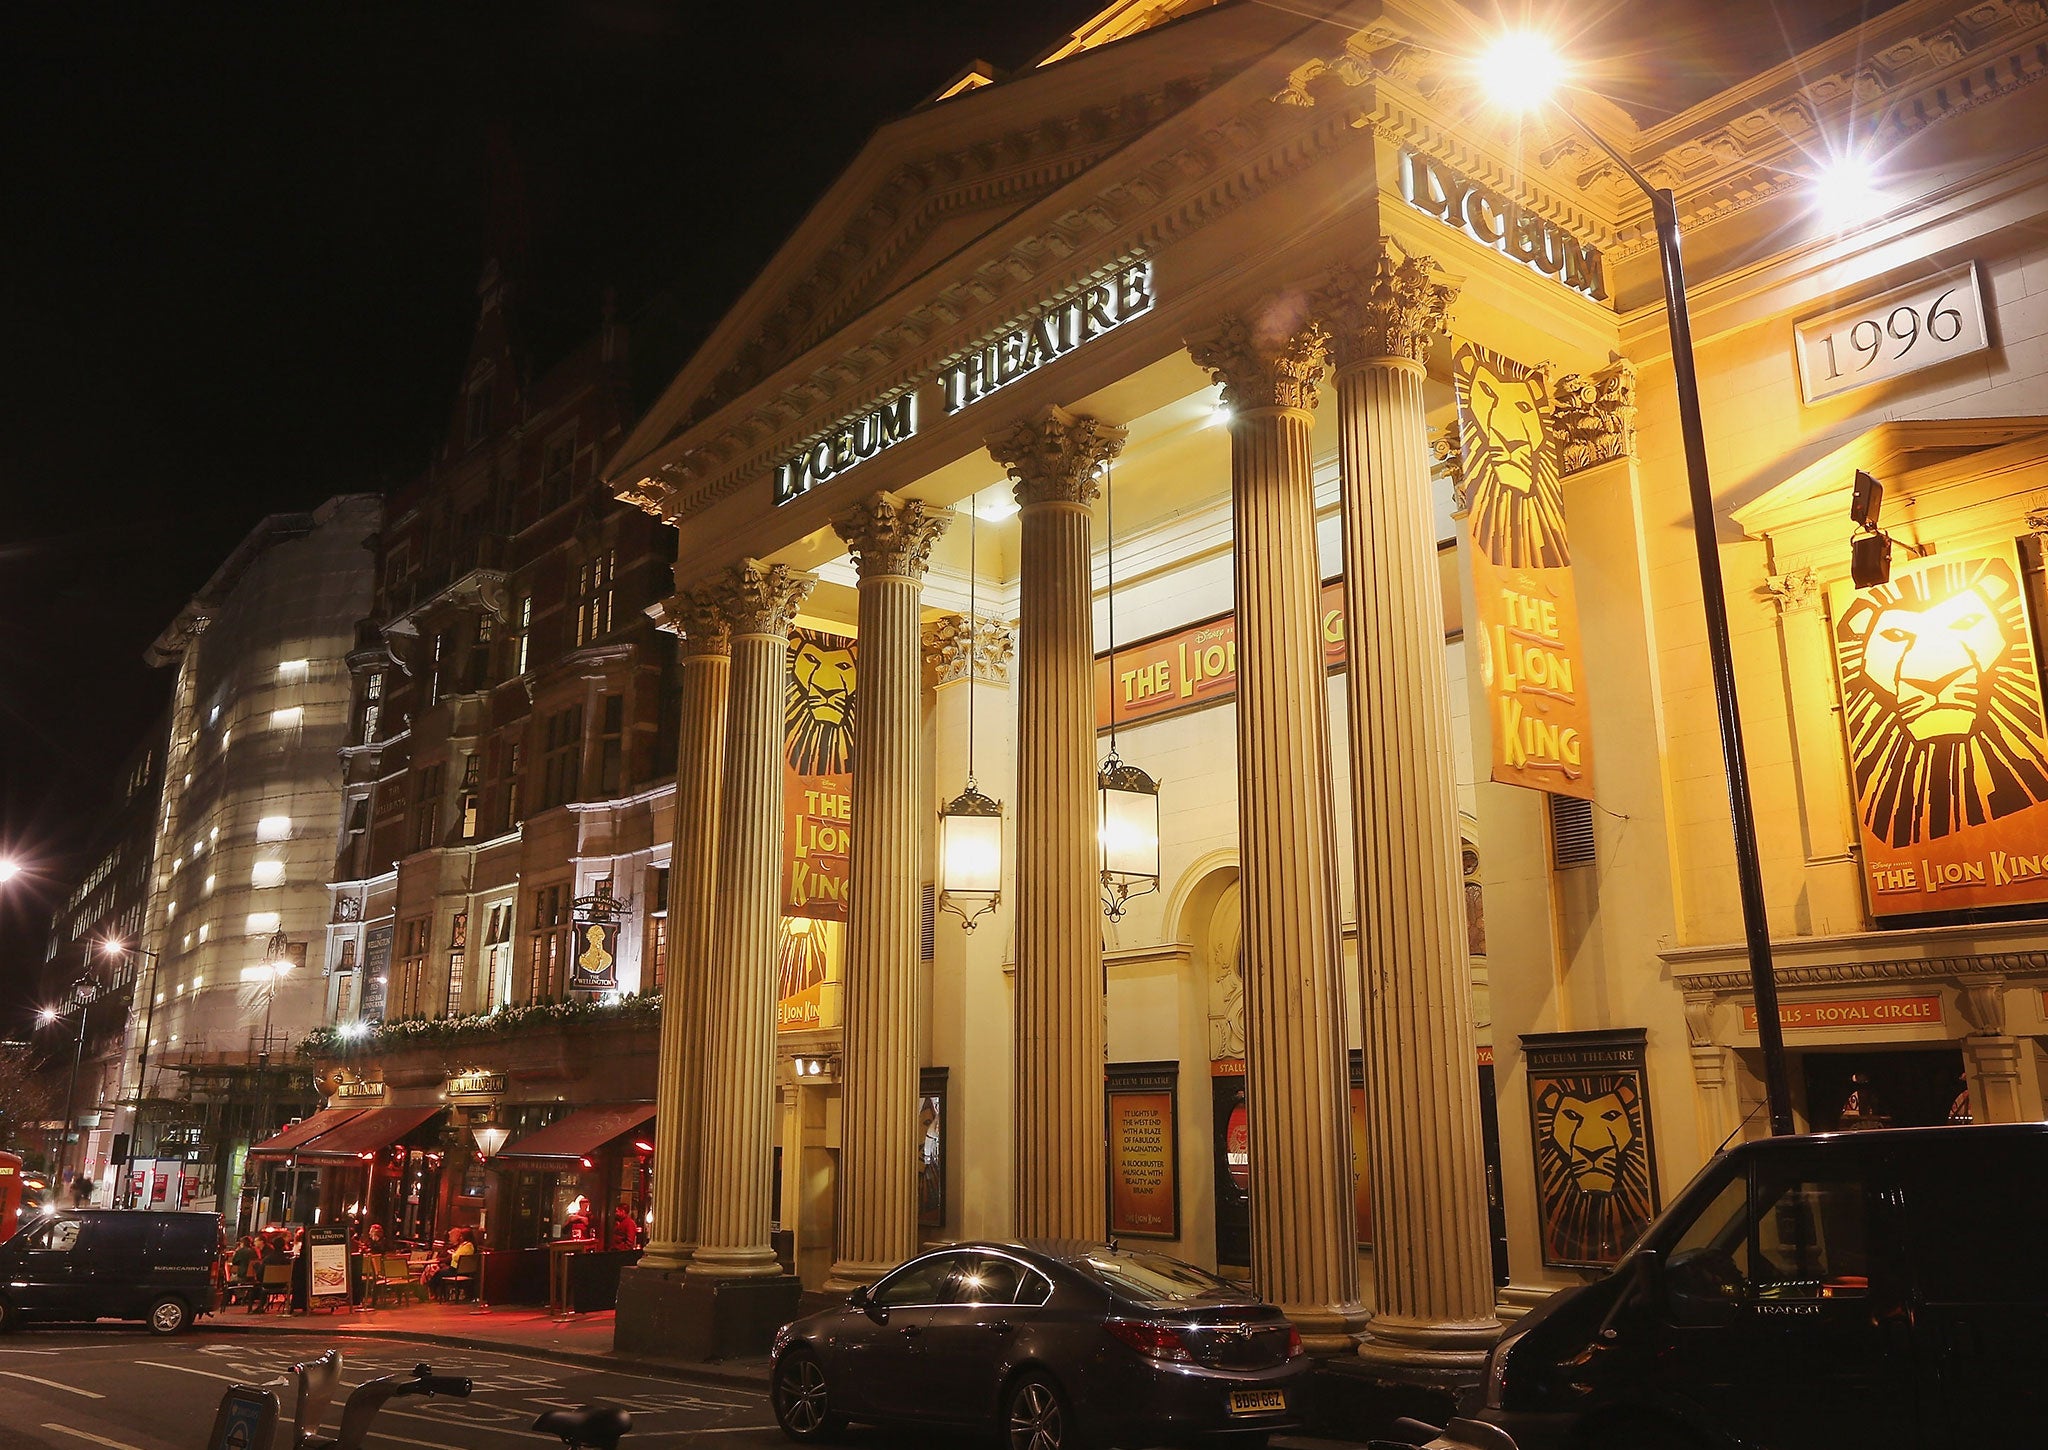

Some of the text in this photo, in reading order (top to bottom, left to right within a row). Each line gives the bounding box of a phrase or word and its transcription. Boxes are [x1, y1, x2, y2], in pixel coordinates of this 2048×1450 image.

[1398, 144, 1609, 301] LYCEUM
[1818, 288, 1963, 381] 1996
[772, 261, 1154, 506] LYCEUM THEATRE
[1502, 587, 1559, 638] THE
[1121, 660, 1171, 703] THE
[1496, 625, 1574, 693] LION
[1499, 696, 1581, 767] KING
[805, 790, 850, 819] THE
[1873, 869, 1917, 890] THE
[1921, 860, 1985, 893] LION
[784, 1003, 803, 1024] LION
[804, 1001, 820, 1022] KIN
[1752, 1009, 1801, 1023] SLLS
[1816, 1007, 1870, 1021] ROYAL
[1874, 1003, 1931, 1019] CIRCLE
[1534, 1050, 1635, 1064] LYCEUM THEATRE
